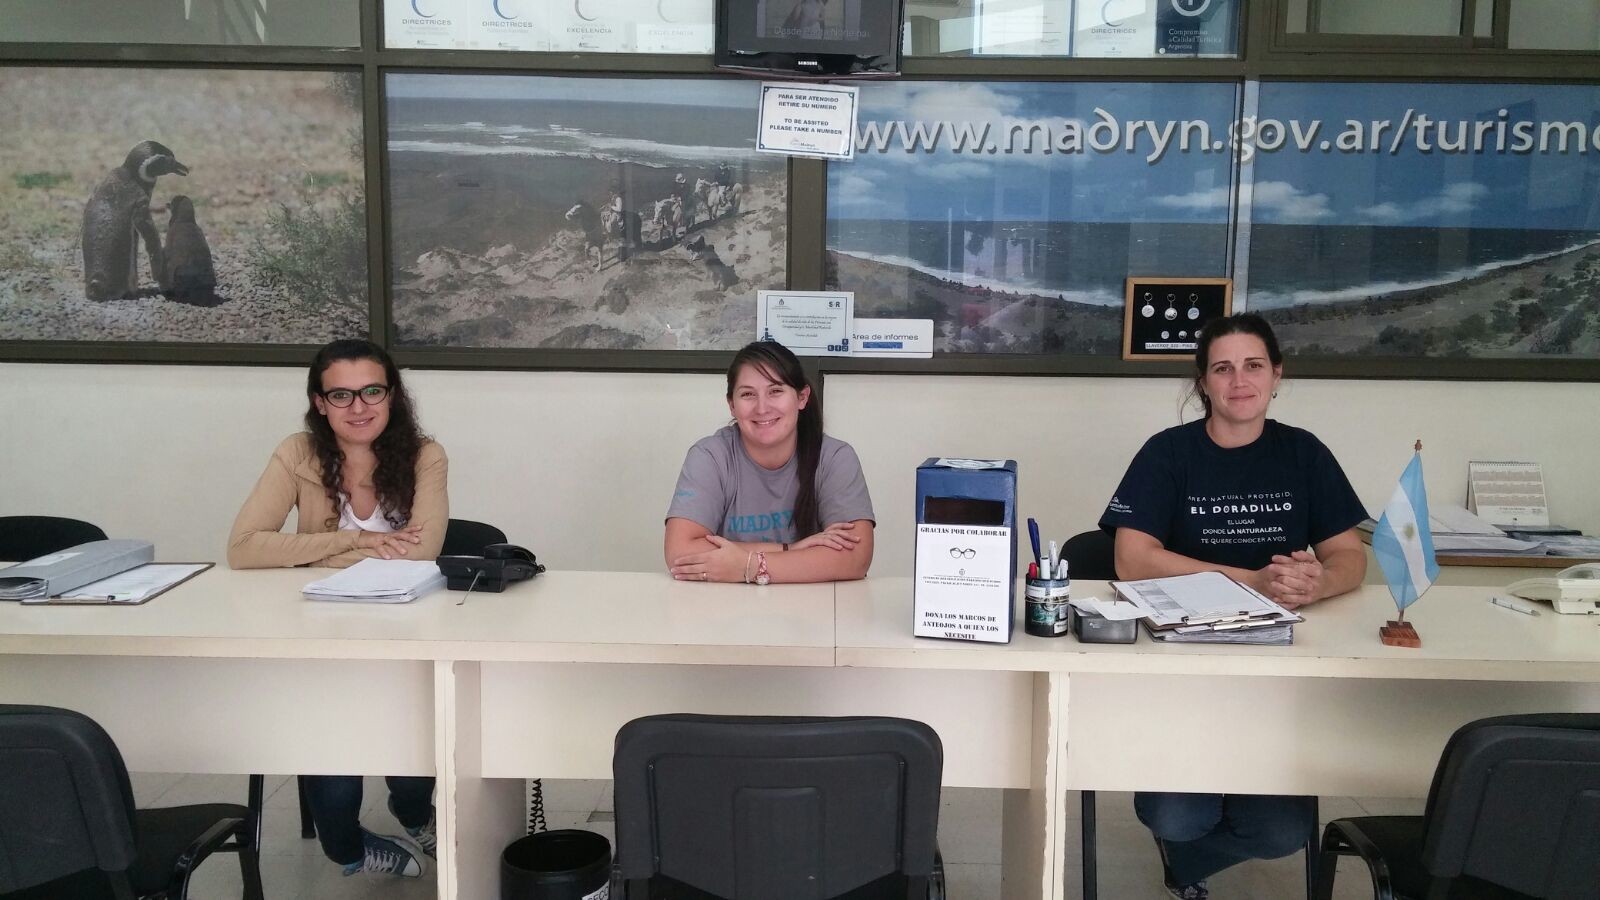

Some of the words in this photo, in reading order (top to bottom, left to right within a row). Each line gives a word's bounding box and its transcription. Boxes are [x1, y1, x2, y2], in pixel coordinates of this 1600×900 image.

[808, 95, 839, 103] ATENDIDO
[855, 106, 1600, 165] www.madryn.gov.ar/turism
[884, 333, 919, 341] informes
[1247, 491, 1292, 499] PROTEGID
[1191, 506, 1206, 514] EL
[1212, 502, 1292, 514] DORADILLO
[966, 529, 1007, 537] COLABORAR
[1236, 526, 1283, 534] NATURALEZA
[925, 611, 943, 619] DONA
[922, 621, 956, 629] ANTEOJOS
